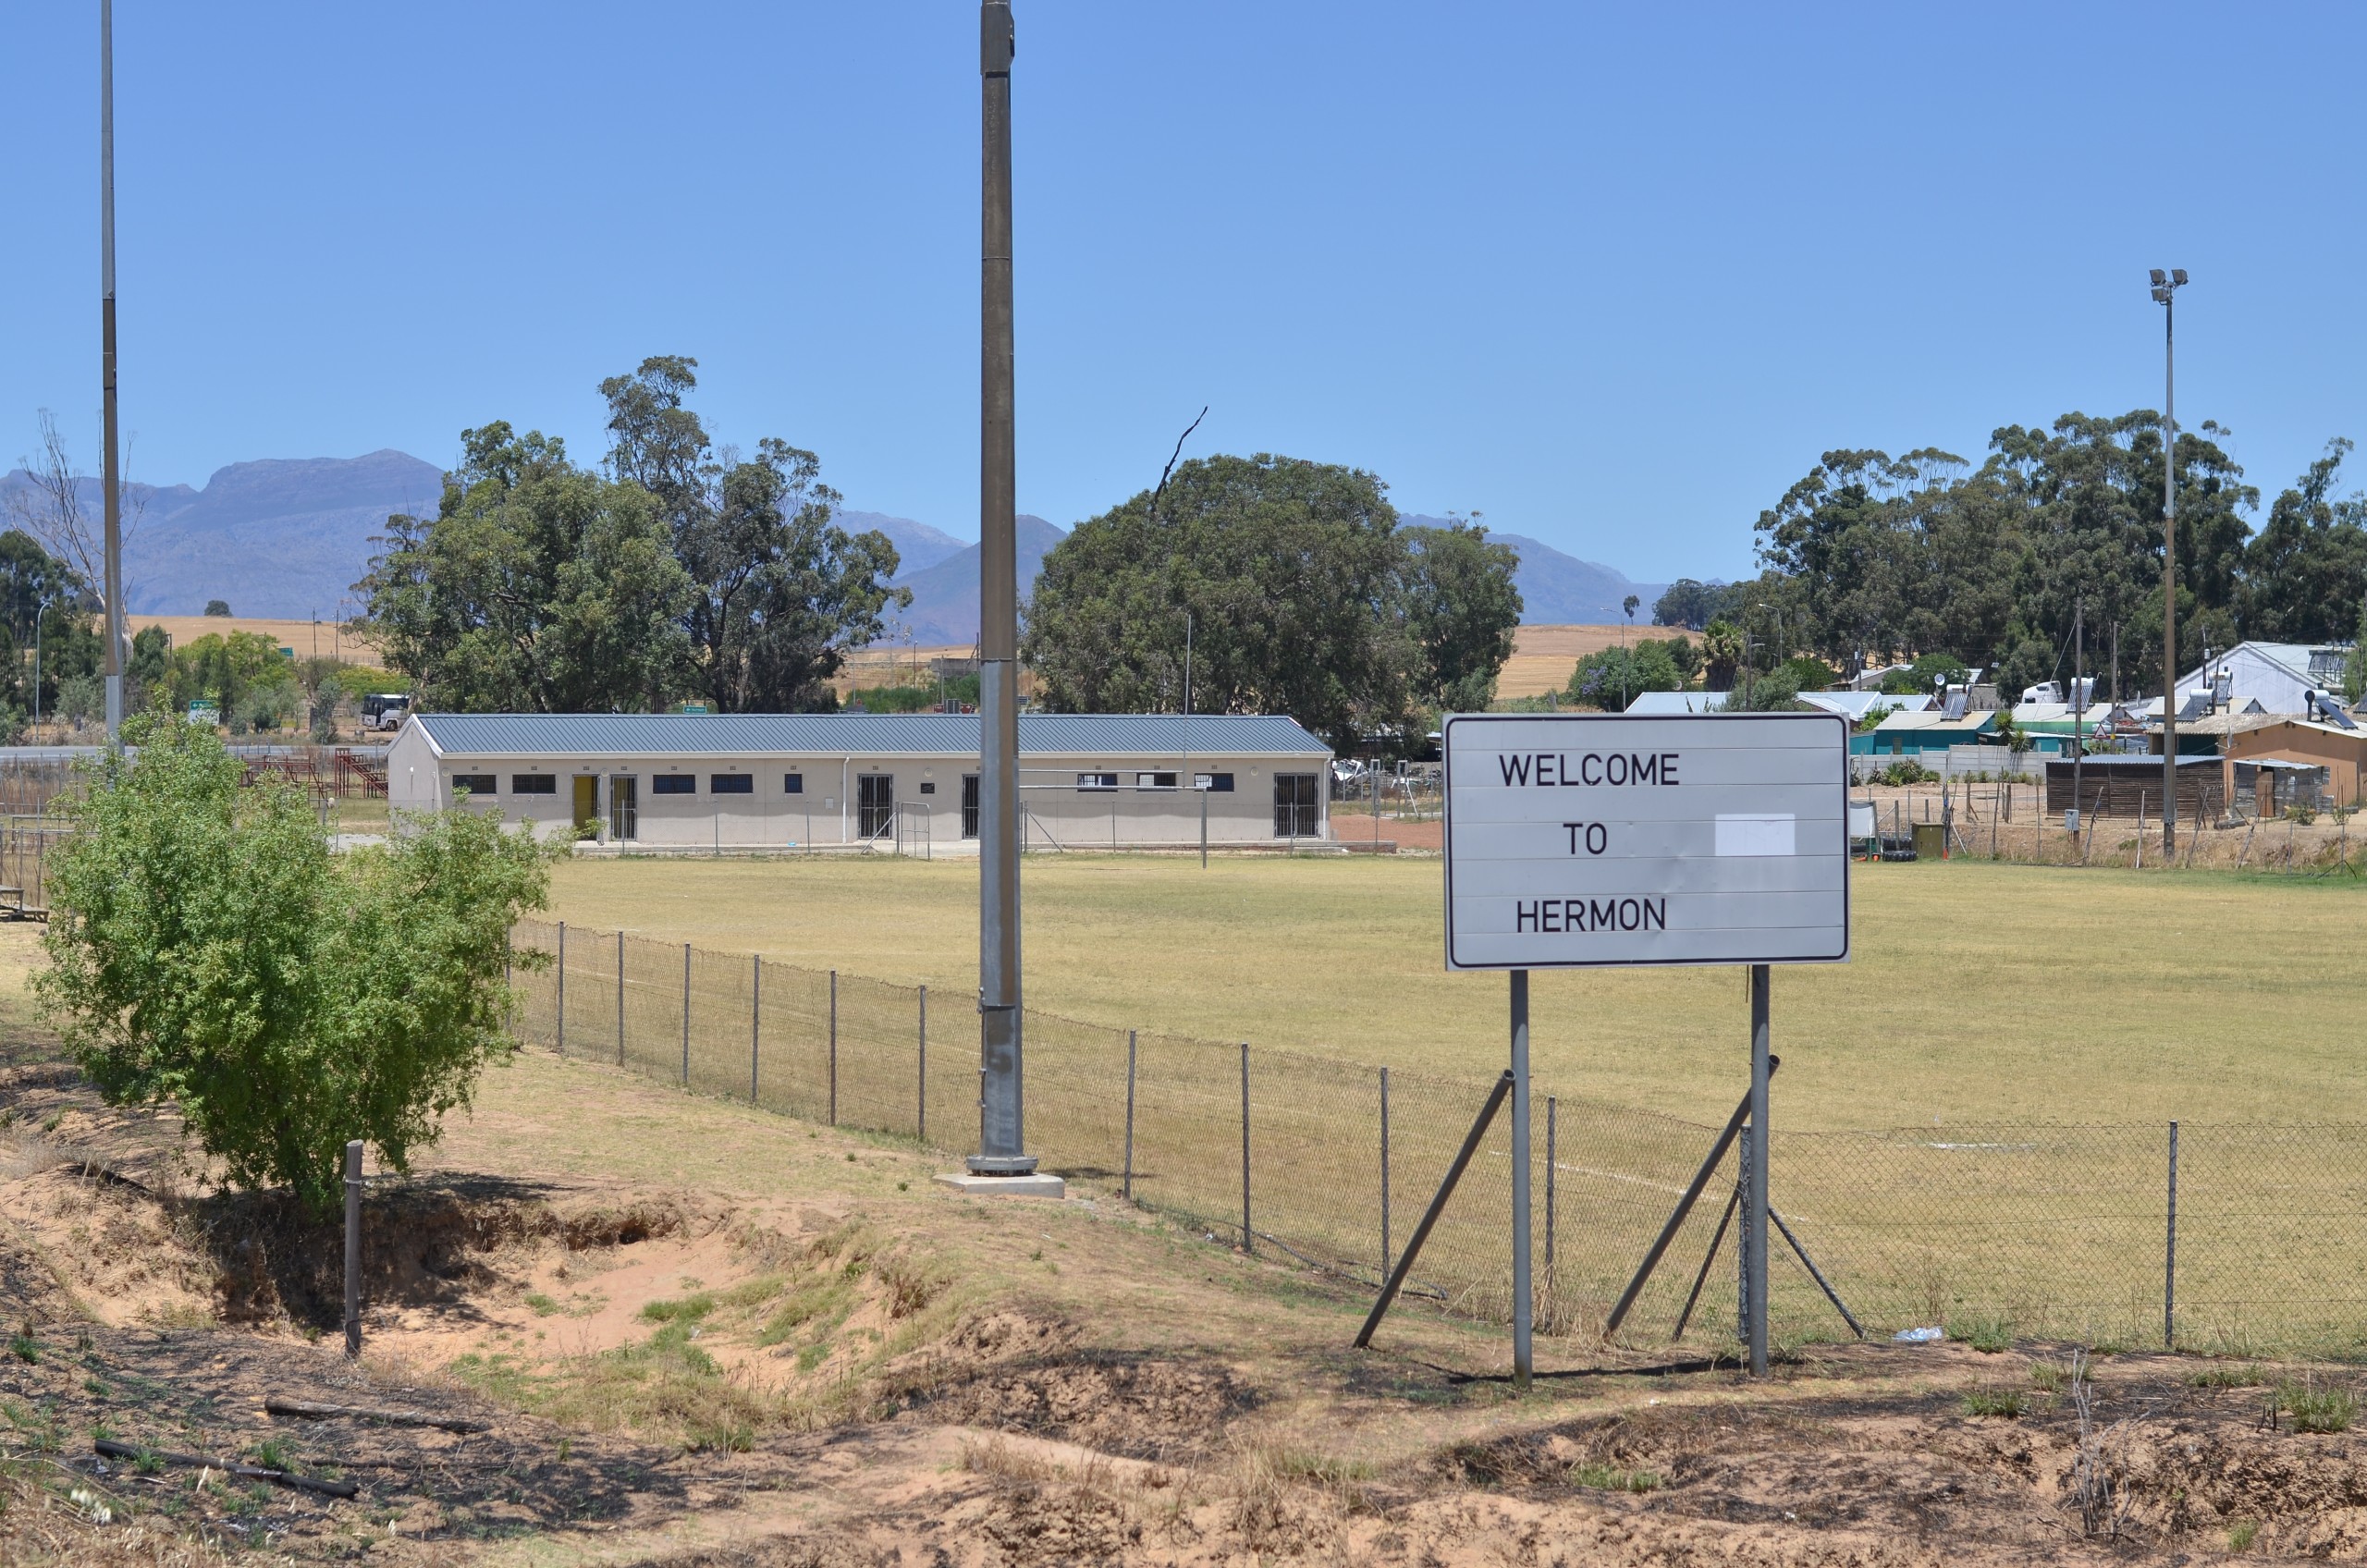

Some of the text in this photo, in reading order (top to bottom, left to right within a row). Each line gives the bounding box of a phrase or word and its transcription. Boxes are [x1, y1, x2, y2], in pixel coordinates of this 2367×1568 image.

[1499, 753, 1680, 787] WELCOME
[1563, 822, 1607, 855] TO
[1517, 898, 1666, 933] HERMON
